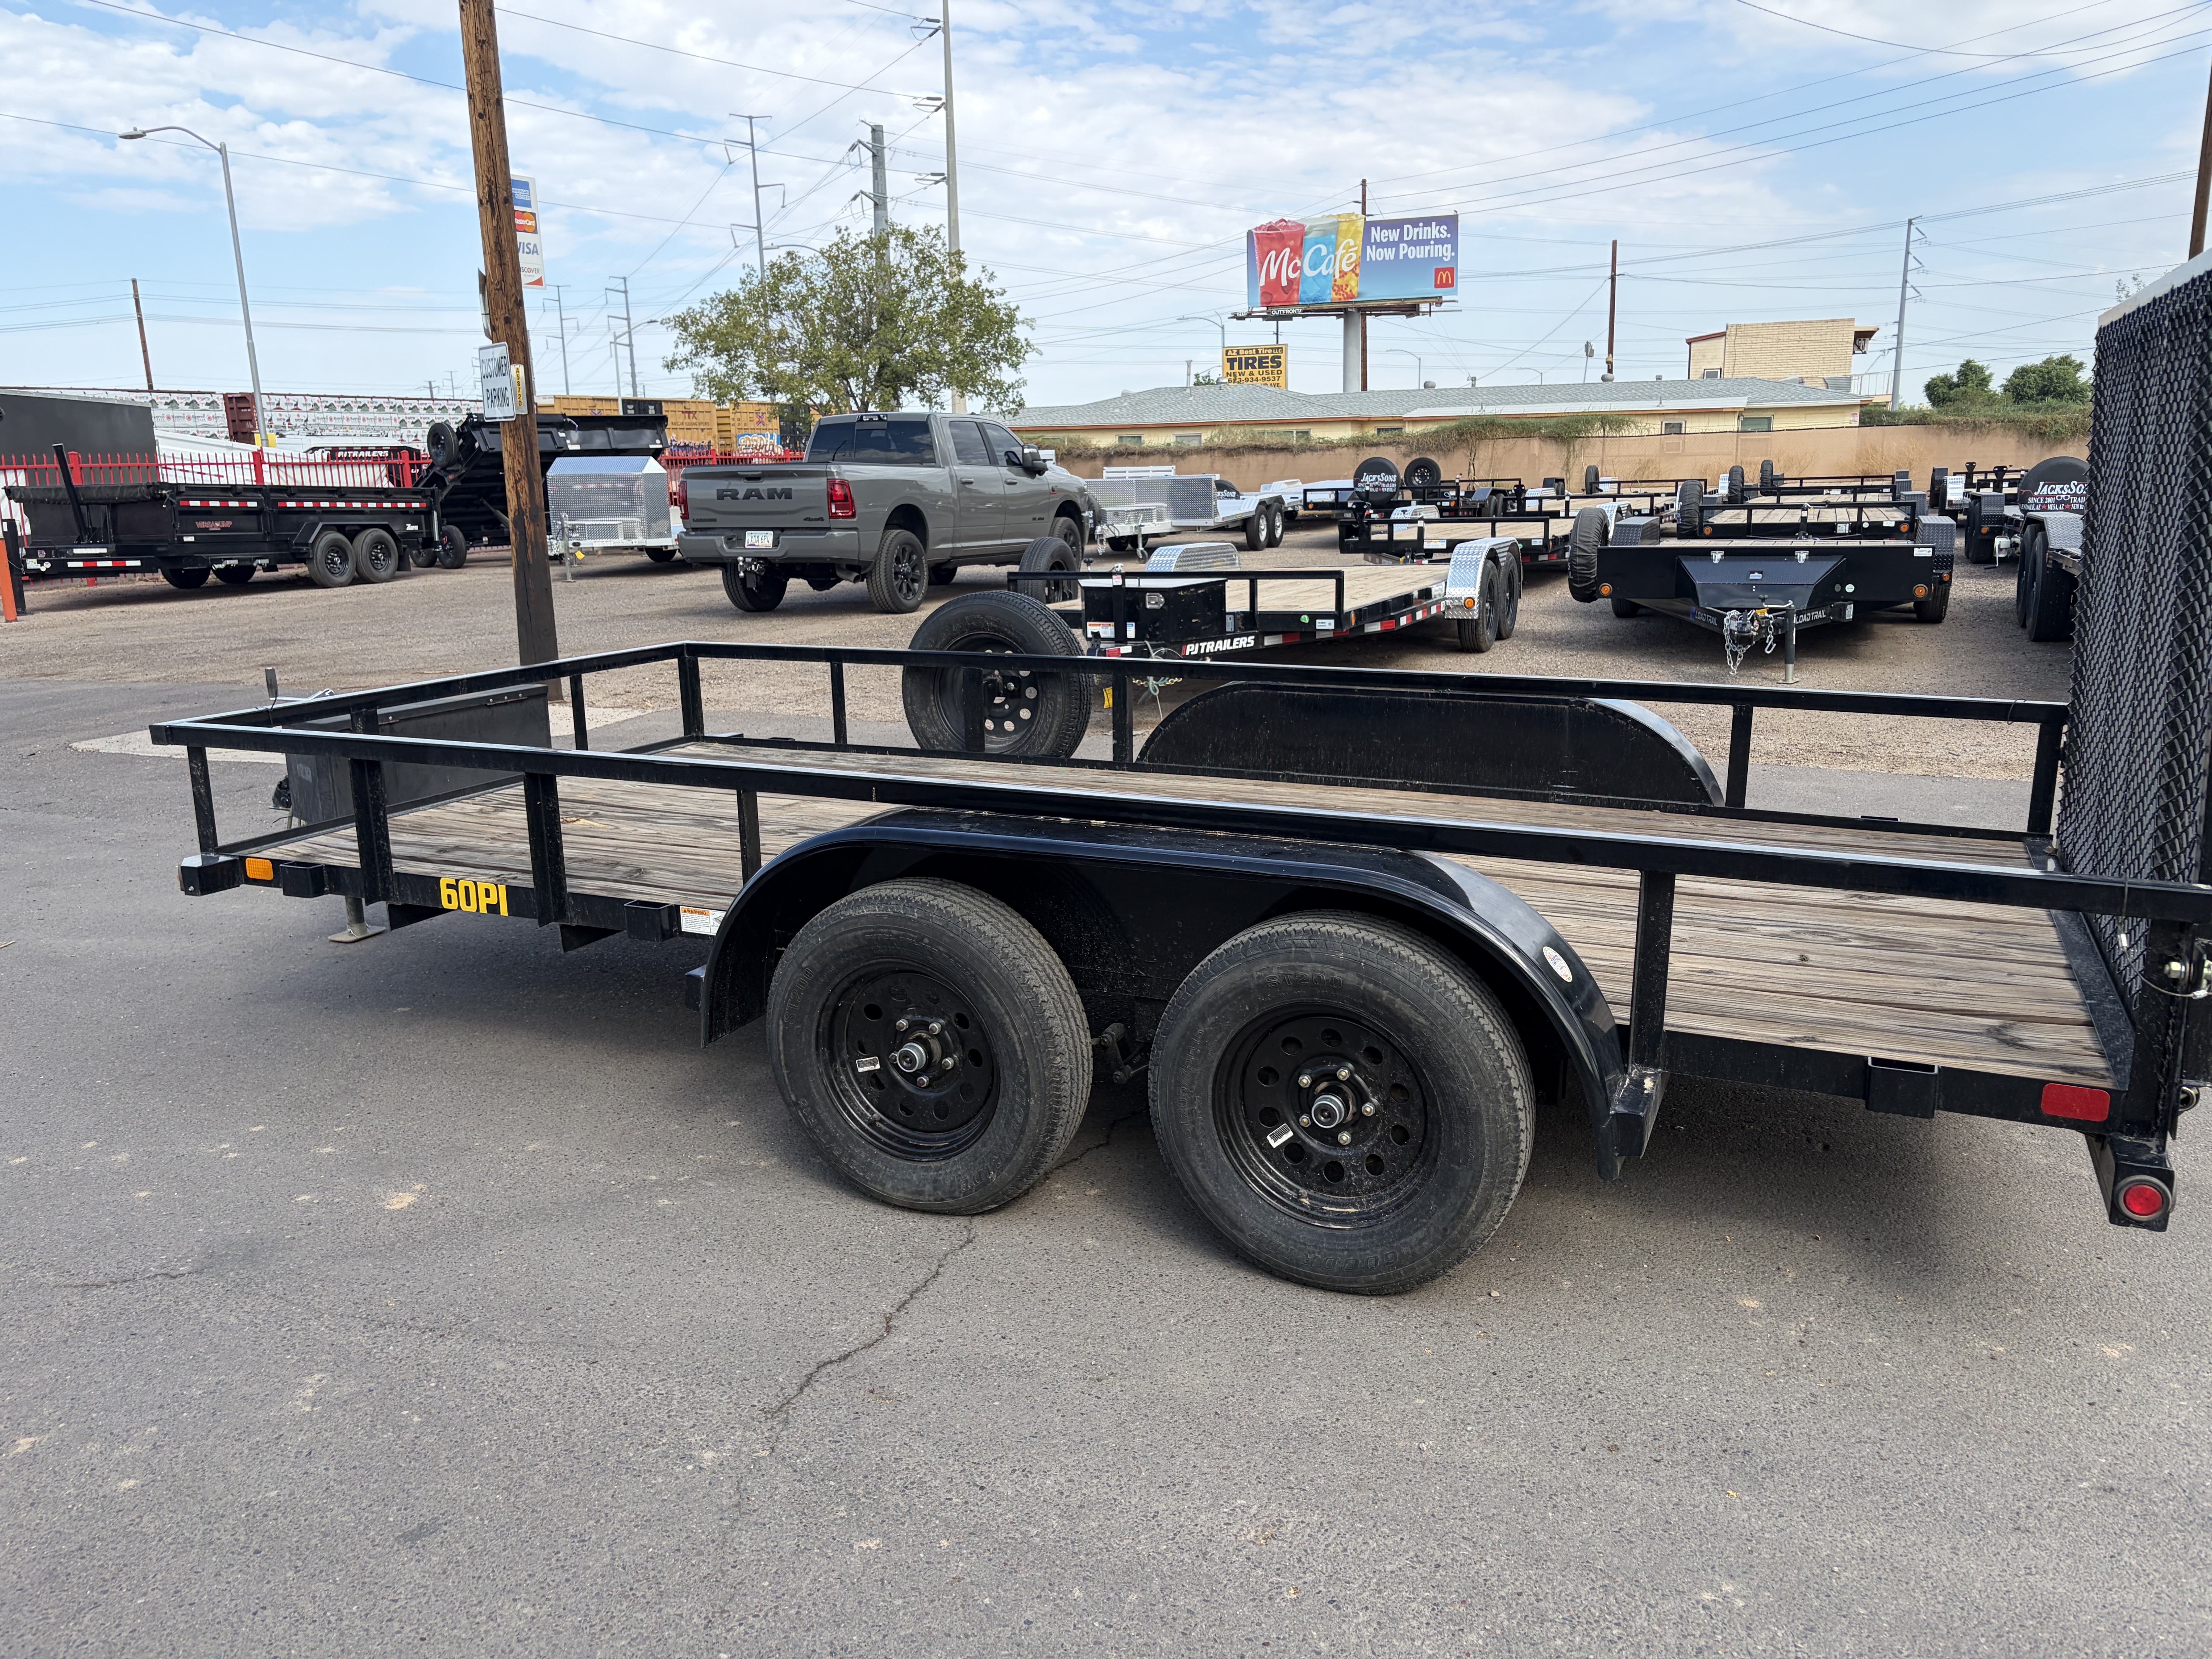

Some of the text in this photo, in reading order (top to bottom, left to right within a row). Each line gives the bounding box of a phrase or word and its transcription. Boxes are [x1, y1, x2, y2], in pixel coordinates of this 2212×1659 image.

[1371, 222, 1451, 242] New Drinks.
[1367, 240, 1455, 261] Now Pouring.
[1260, 239, 1358, 287] McCafé
[481, 356, 508, 379] CUSTOMER
[1226, 355, 1282, 371] TIRES
[486, 386, 509, 409] PARKING
[716, 488, 793, 500] RAM
[2034, 481, 2087, 495] JACKSSO
[1695, 610, 1717, 626] LOAD TRAIL
[1796, 609, 1826, 624] LOAD TRAIL
[1264, 972, 1343, 989] ST200
[783, 967, 815, 1025] ST200
[1247, 1229, 1399, 1271] GOODRIDE
